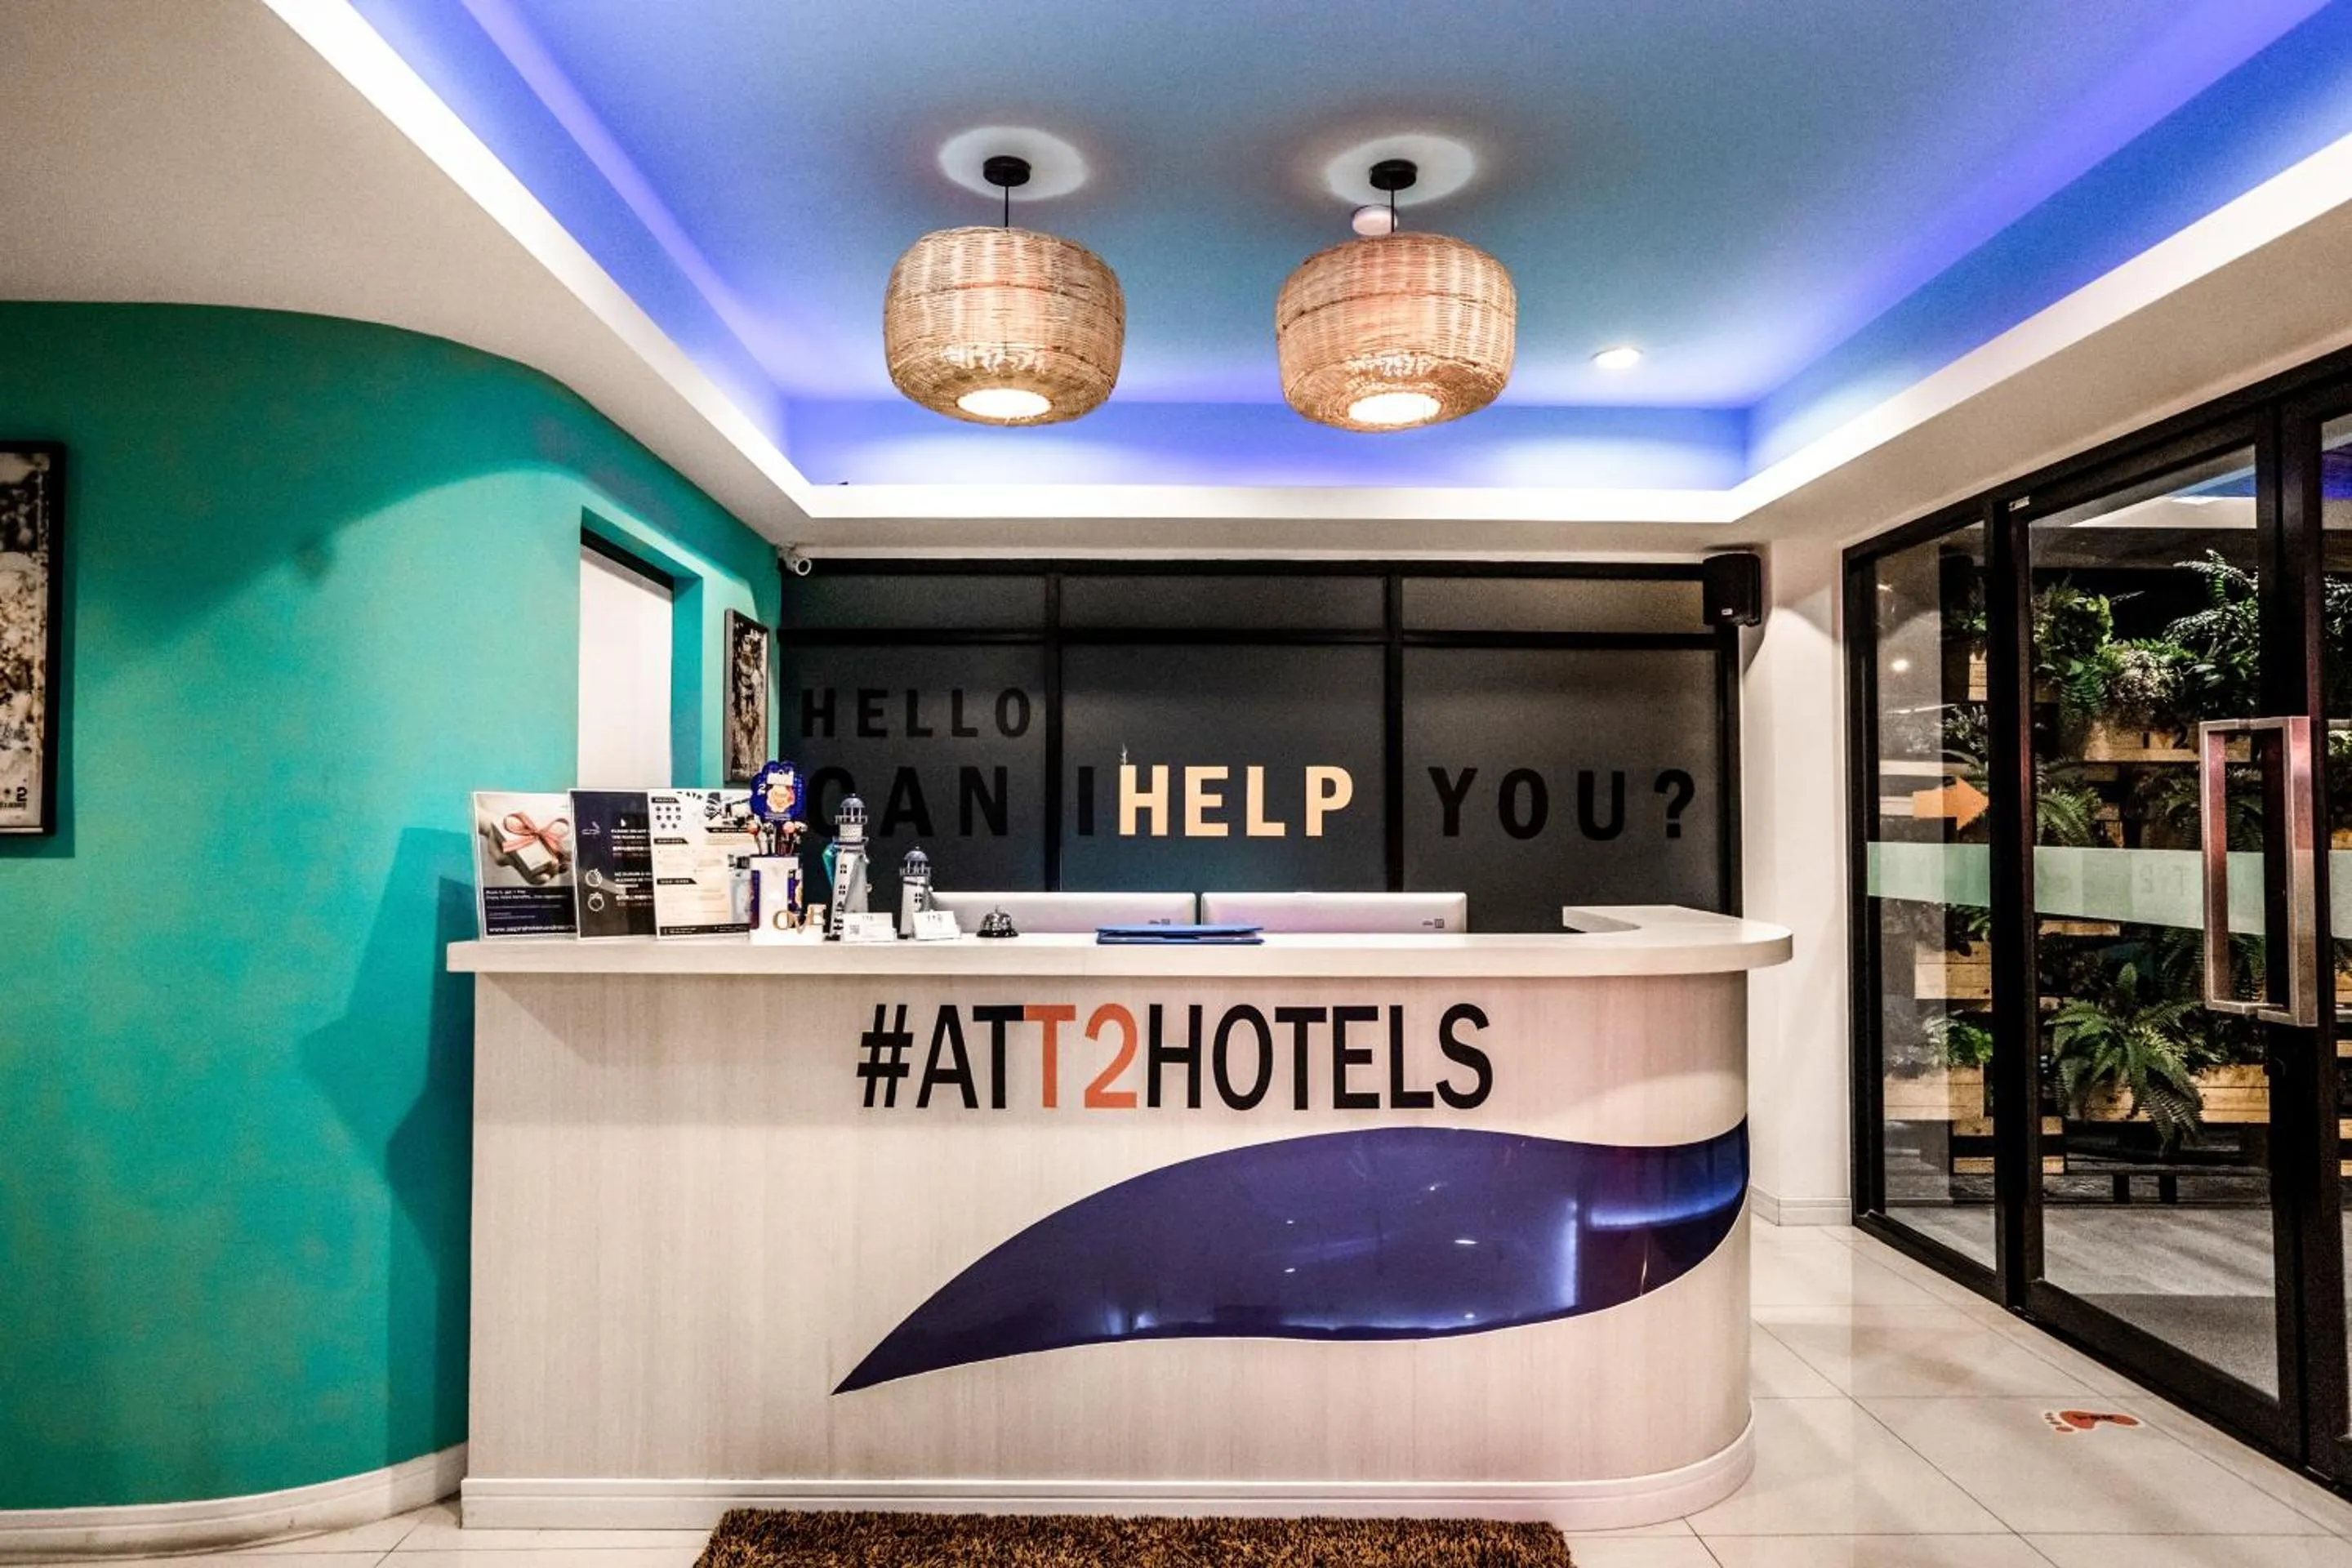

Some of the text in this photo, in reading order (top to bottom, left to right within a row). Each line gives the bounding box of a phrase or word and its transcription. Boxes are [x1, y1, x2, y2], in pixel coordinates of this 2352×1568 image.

[801, 687, 1031, 739] HELLO
[806, 765, 1696, 841] CAN I HELP YOU?
[857, 1003, 1493, 1111] #ATT2HOTELS
